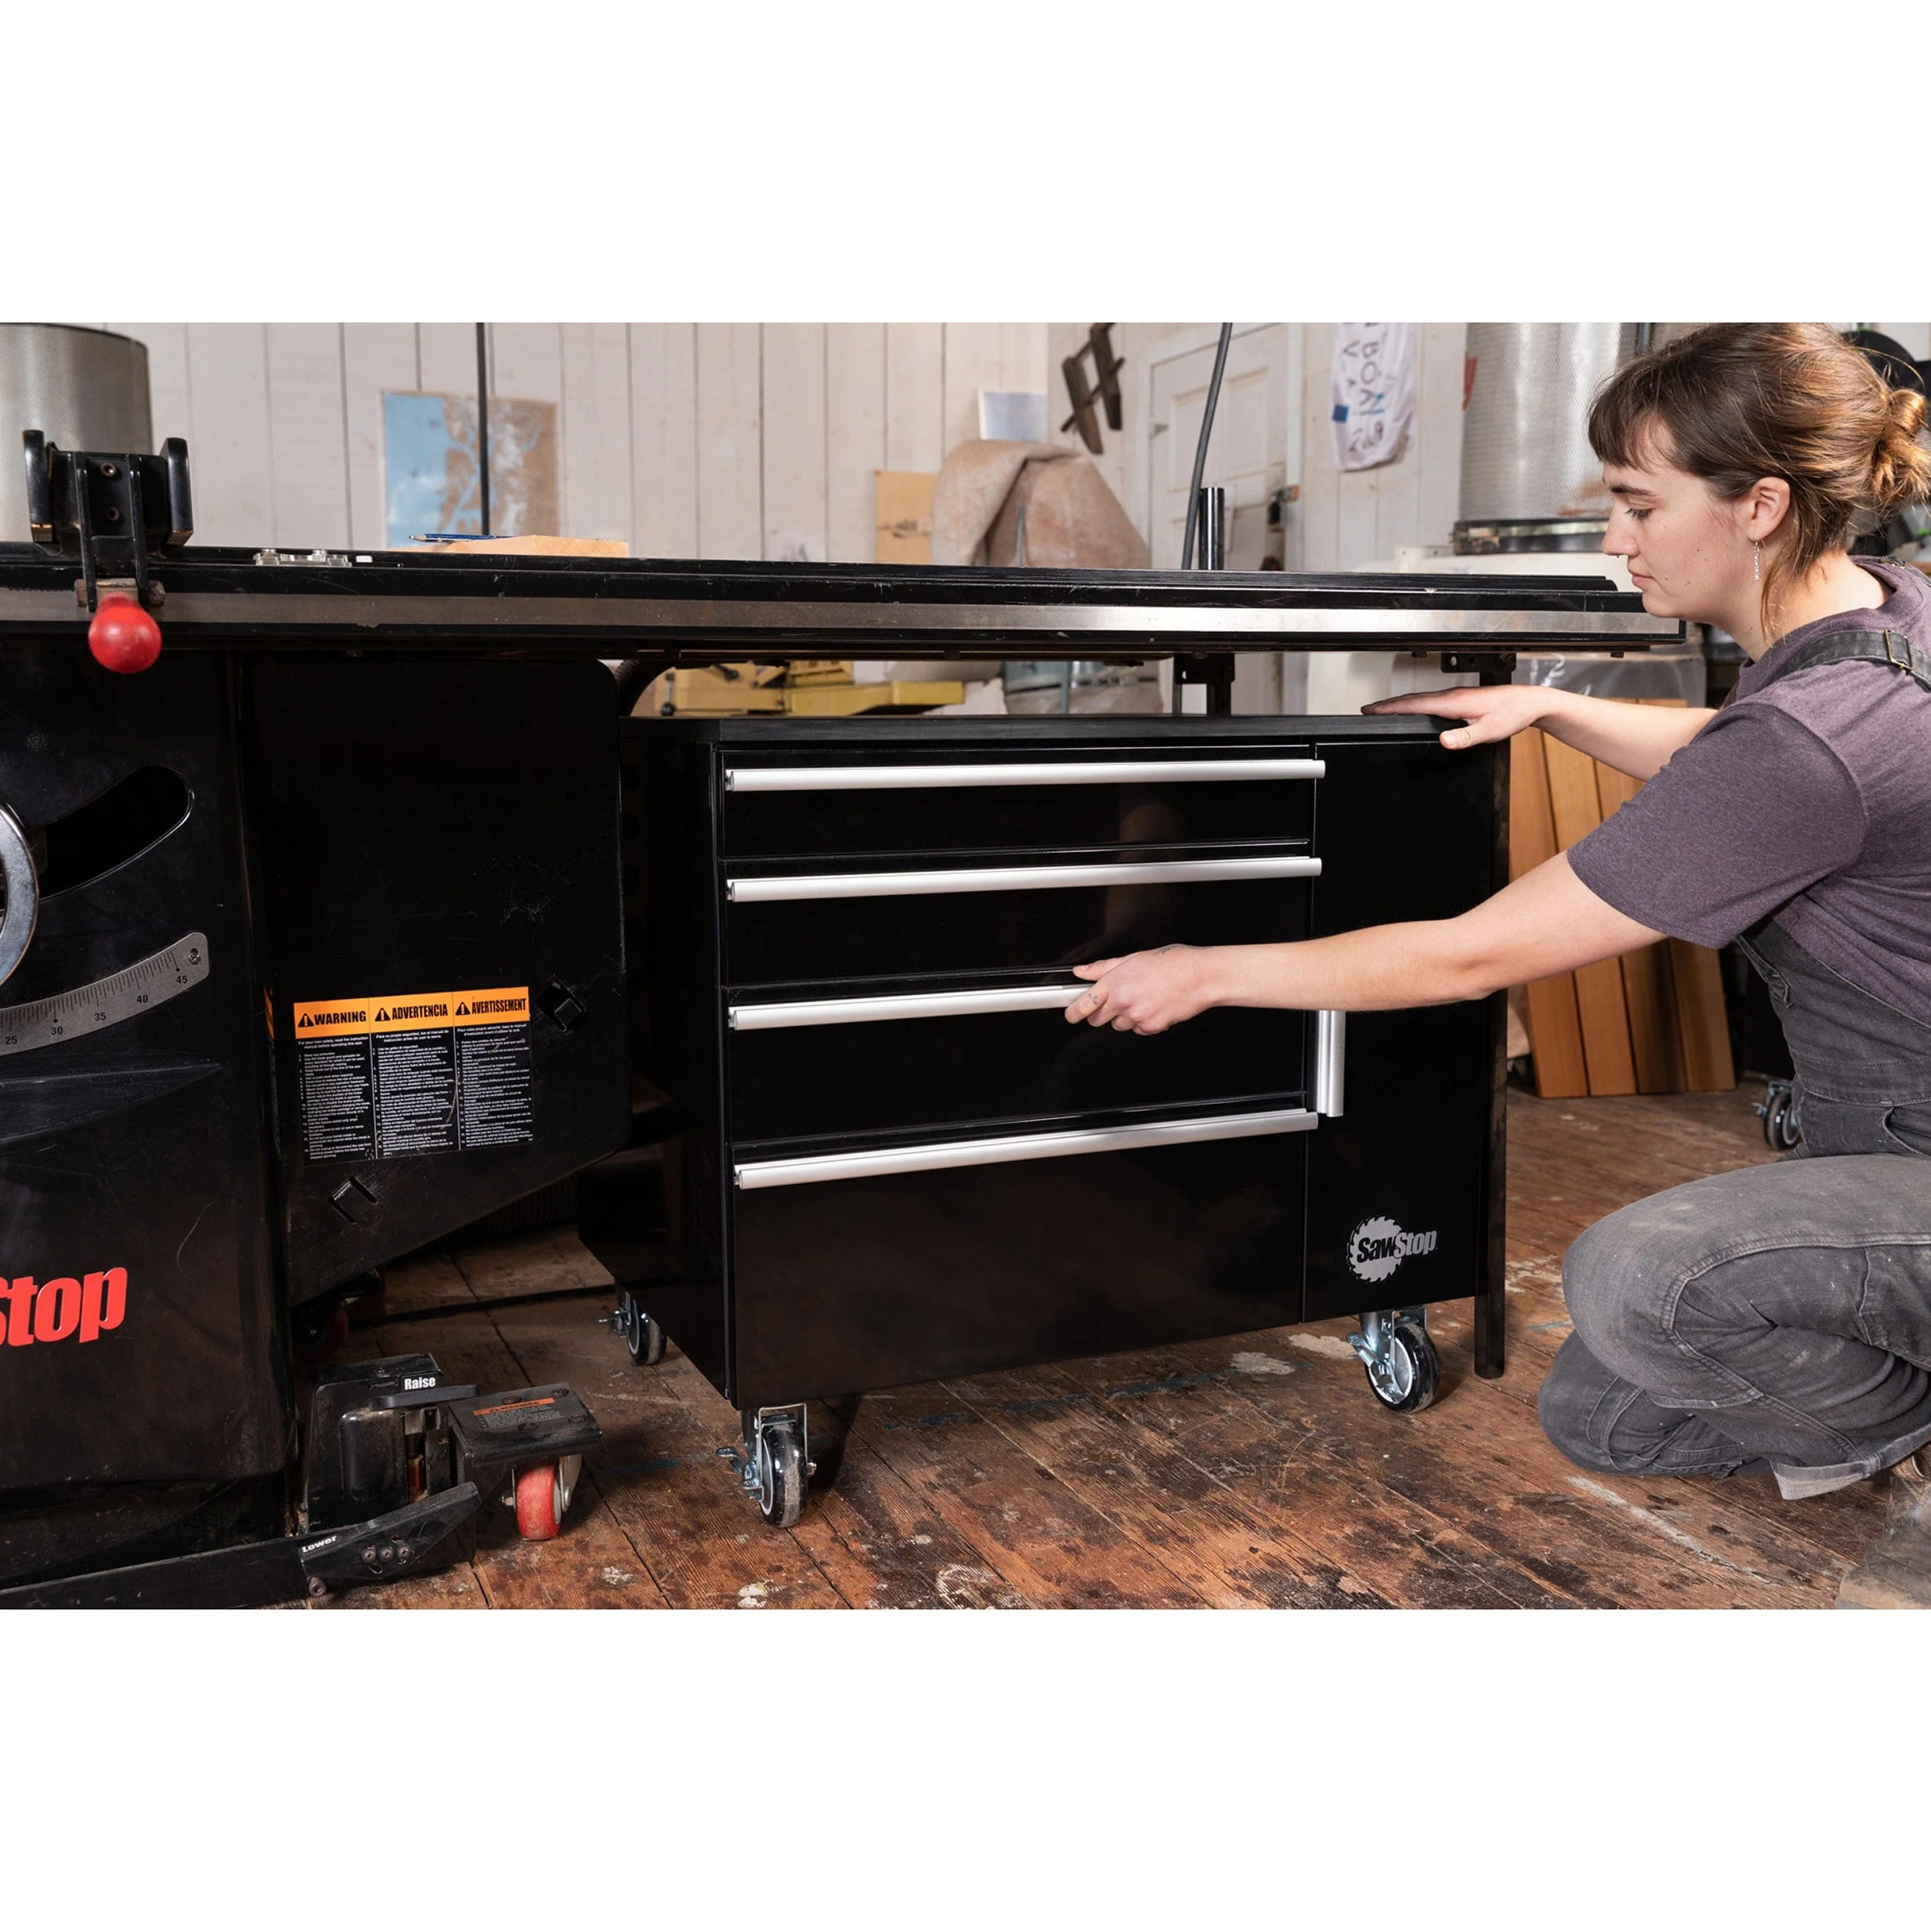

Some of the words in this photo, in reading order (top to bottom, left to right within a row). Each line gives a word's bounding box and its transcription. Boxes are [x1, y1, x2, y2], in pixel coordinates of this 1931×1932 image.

[176, 975, 188, 984] 45
[136, 994, 148, 1003] 40
[392, 1003, 448, 1020] ADVERTENCIA
[471, 998, 527, 1014] AVERTISSEMENT
[94, 1012, 107, 1021] 35
[314, 1010, 367, 1025] WARNING
[51, 1027, 63, 1035] 30
[5, 1036, 18, 1044] 25
[1356, 1230, 1437, 1263] SawStop
[0, 1267, 128, 1346] top
[404, 1377, 436, 1390] Raise
[301, 1535, 337, 1553] Lower
